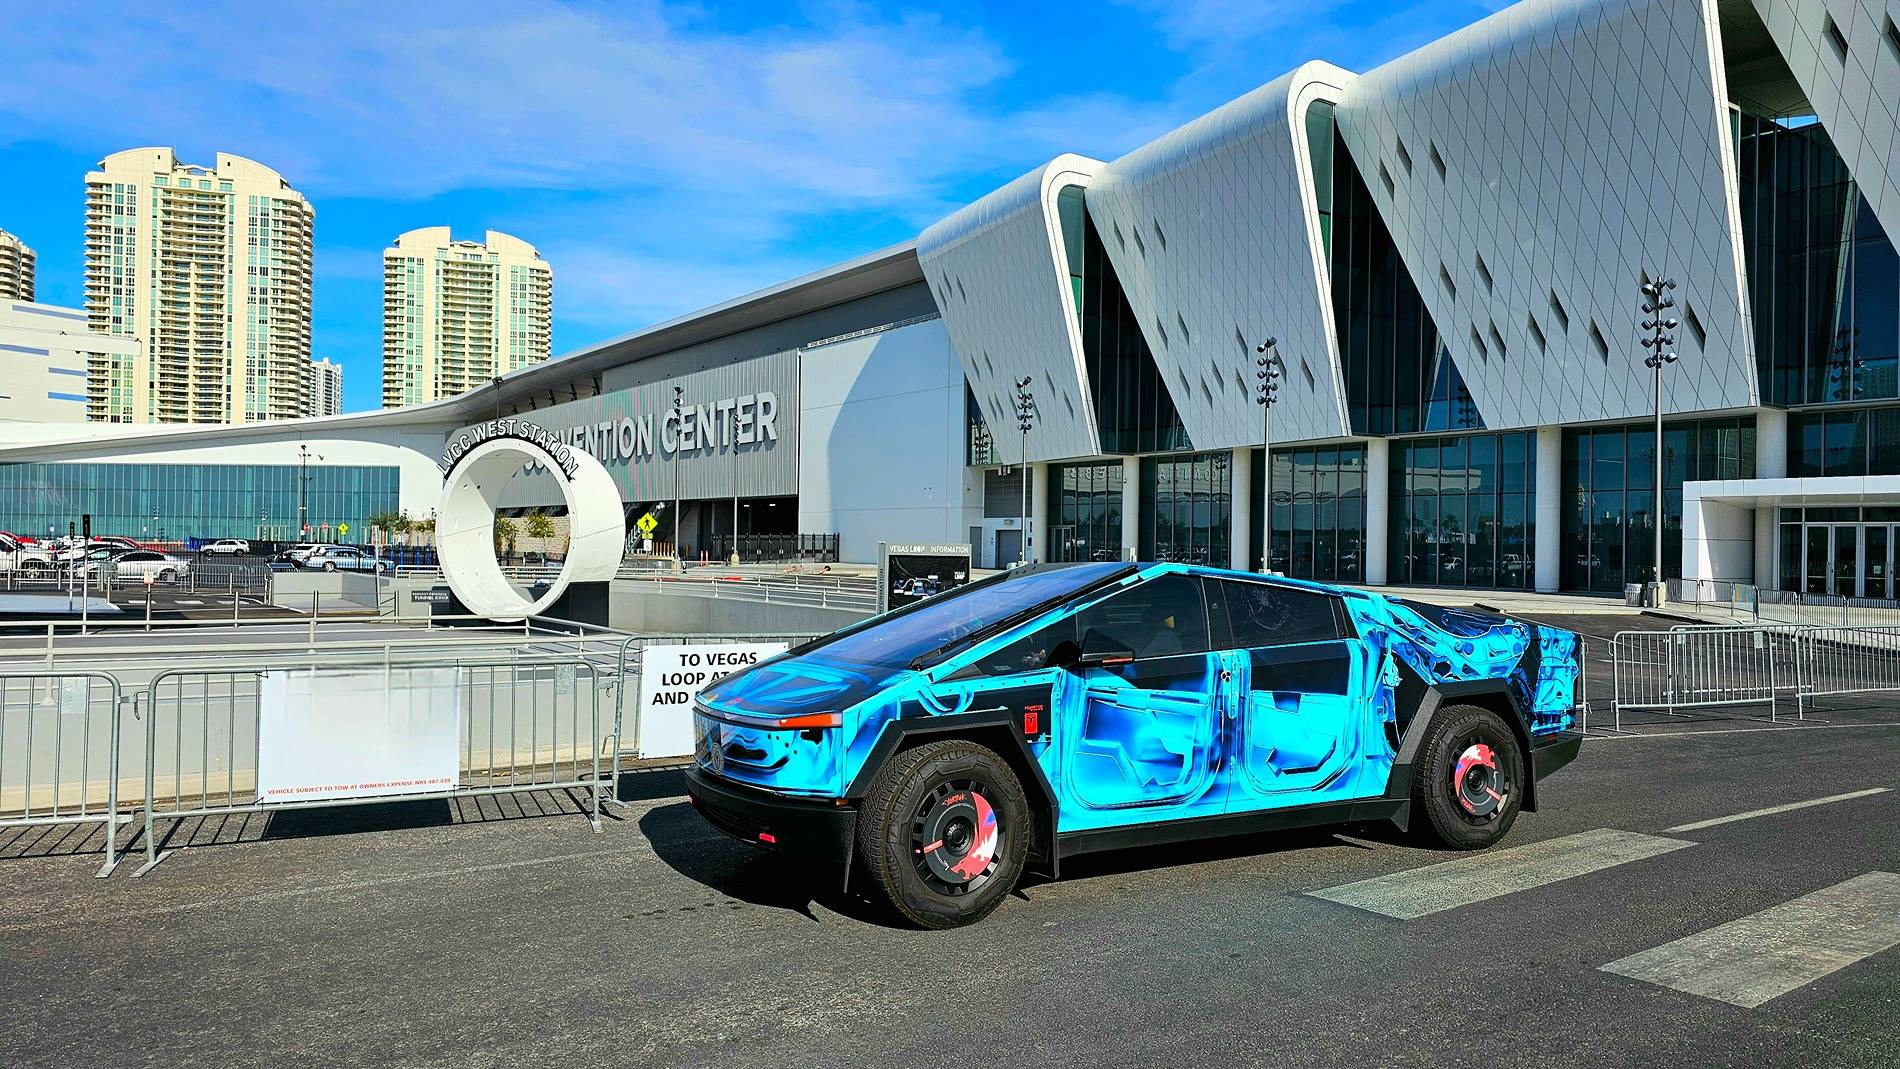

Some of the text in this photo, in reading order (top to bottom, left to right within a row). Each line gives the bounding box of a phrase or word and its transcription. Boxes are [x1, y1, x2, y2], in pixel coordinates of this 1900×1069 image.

[661, 391, 779, 453] CENTER
[436, 419, 579, 475] LVCC WEST STATION
[889, 545, 969, 554] VEGAS LOOP INFORMATION
[680, 652, 757, 667] TO VEGAS
[662, 672, 706, 686] LOOP
[652, 691, 689, 705] AND
